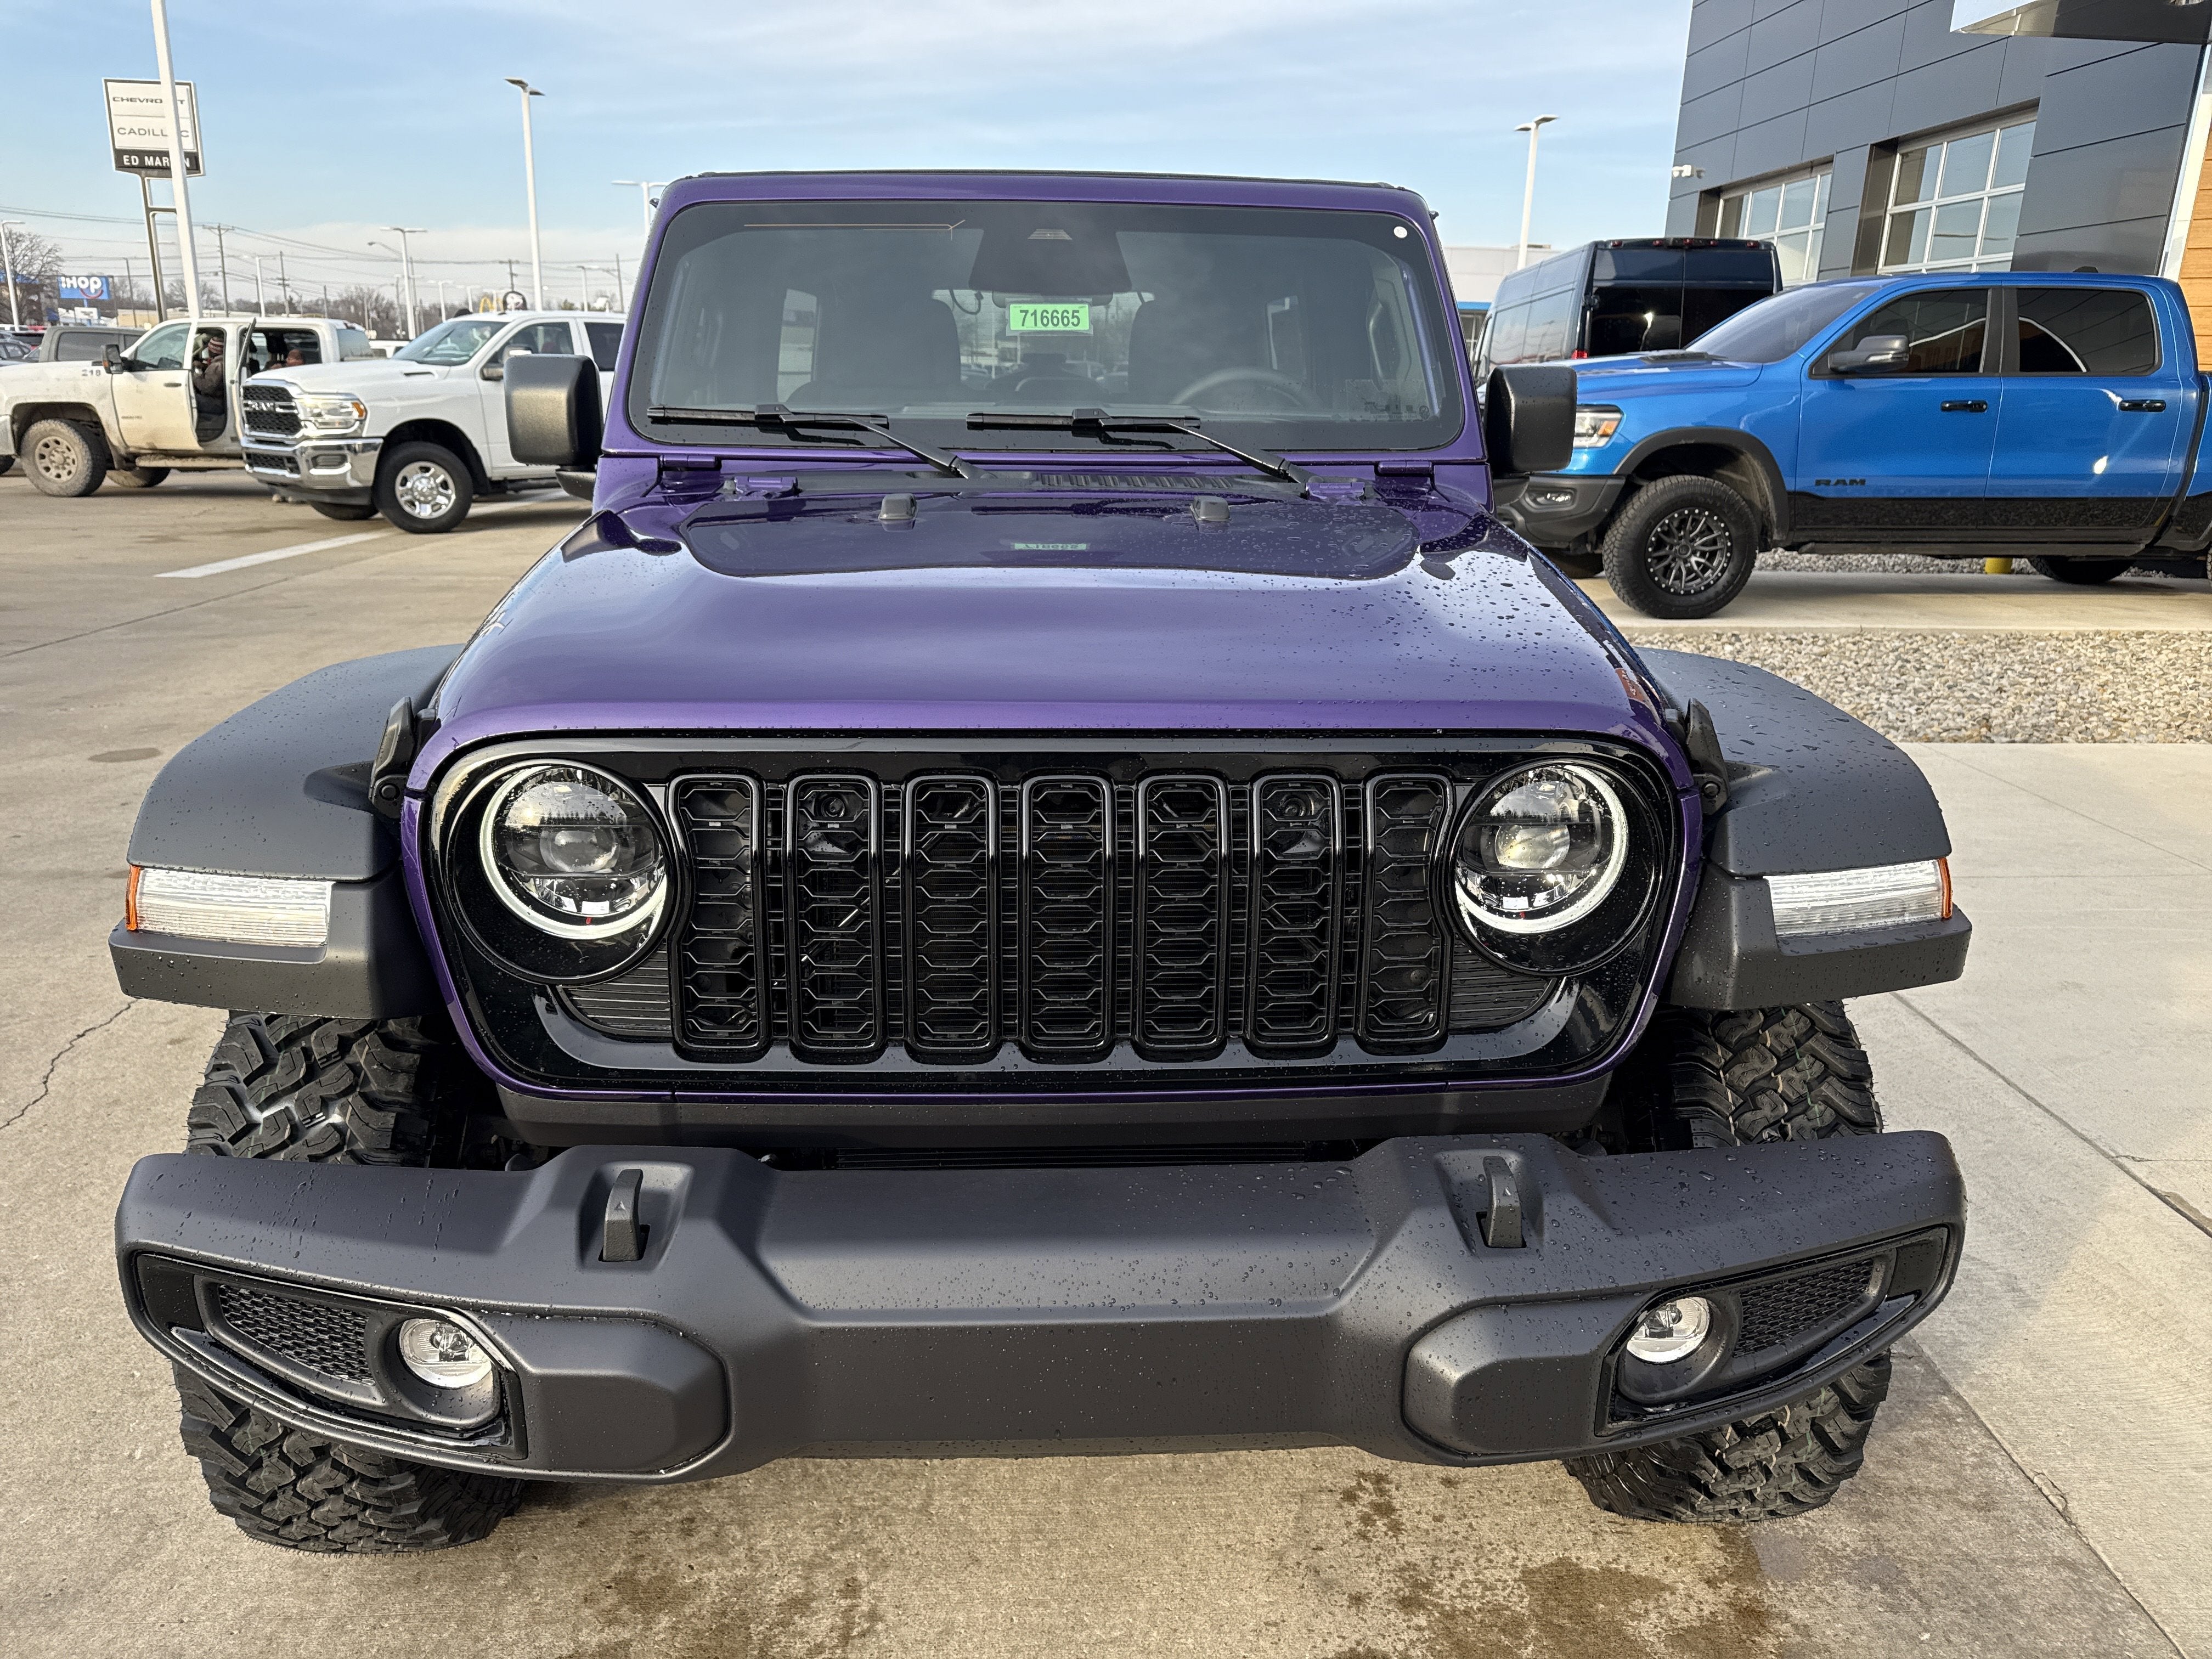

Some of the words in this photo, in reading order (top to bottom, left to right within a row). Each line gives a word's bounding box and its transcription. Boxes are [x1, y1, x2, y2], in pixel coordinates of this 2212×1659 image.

[112, 97, 185, 105] CHEVROT
[117, 127, 189, 138] CADILLC
[123, 155, 139, 165] ED
[144, 156, 190, 167] MARN
[1019, 309, 1080, 327] 716665
